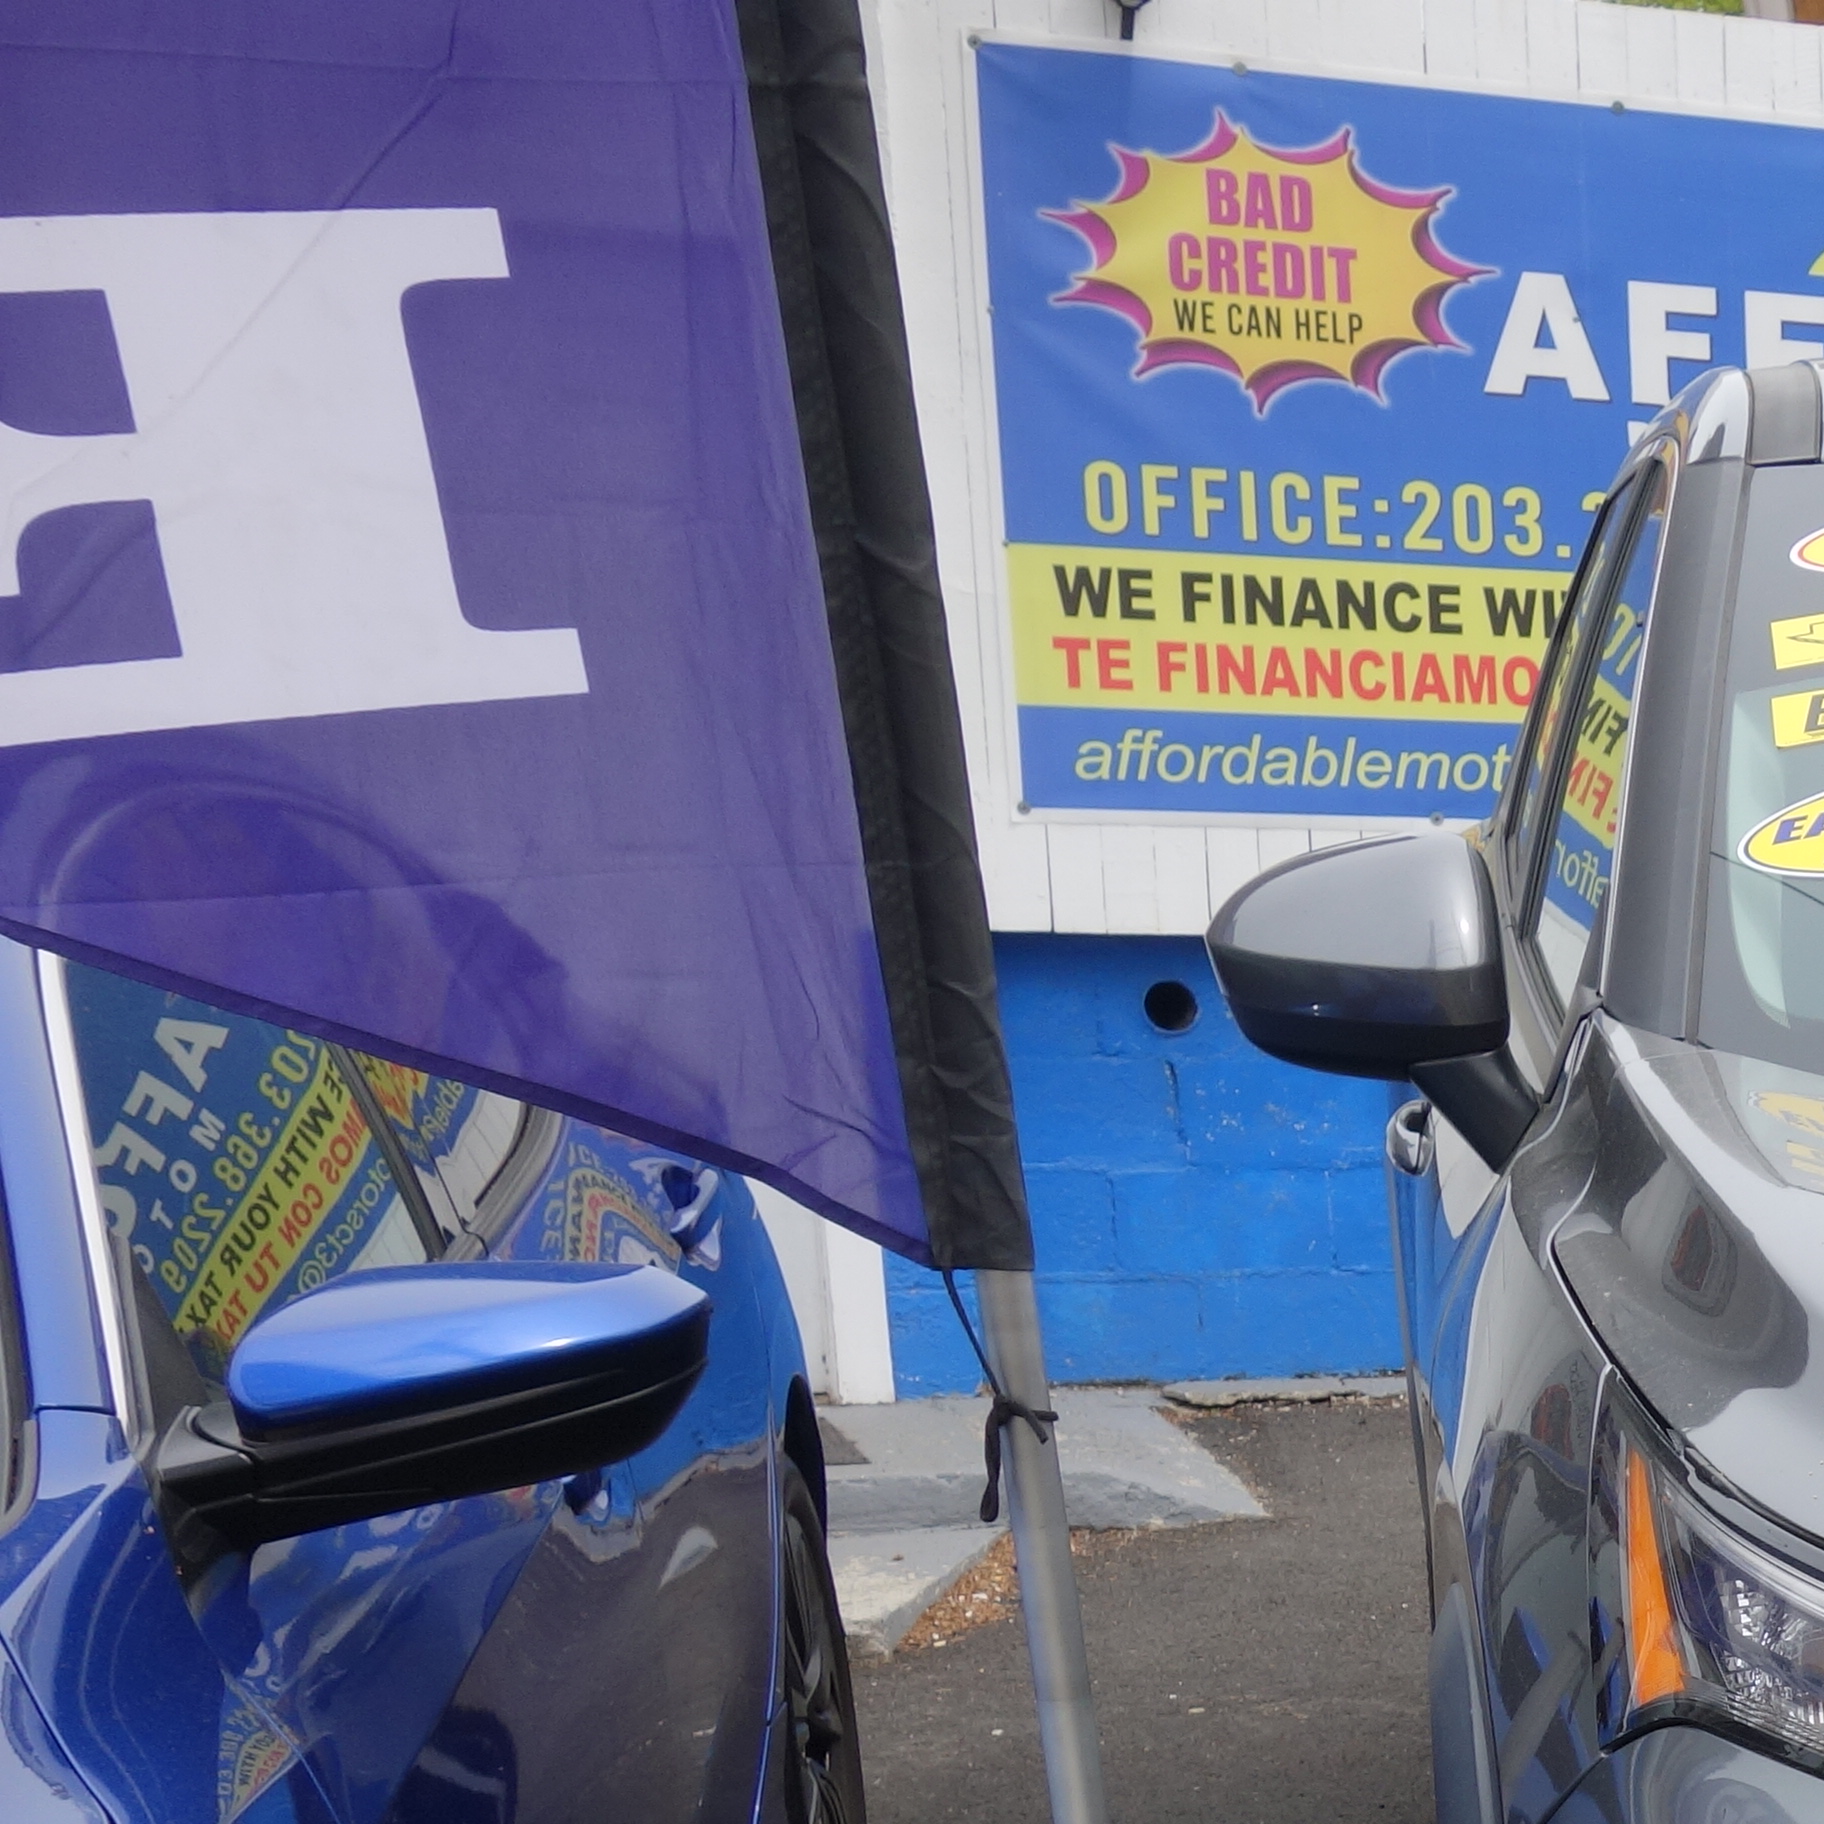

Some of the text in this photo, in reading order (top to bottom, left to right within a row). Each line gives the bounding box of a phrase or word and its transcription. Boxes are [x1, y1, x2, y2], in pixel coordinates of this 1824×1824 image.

[1206, 168, 1313, 232] BAD
[1168, 232, 1358, 304] CREDIT
[1173, 298, 1363, 344] WE CAN HELP
[1053, 564, 1568, 638] WE FINANCE WI
[1052, 637, 1133, 690] TE
